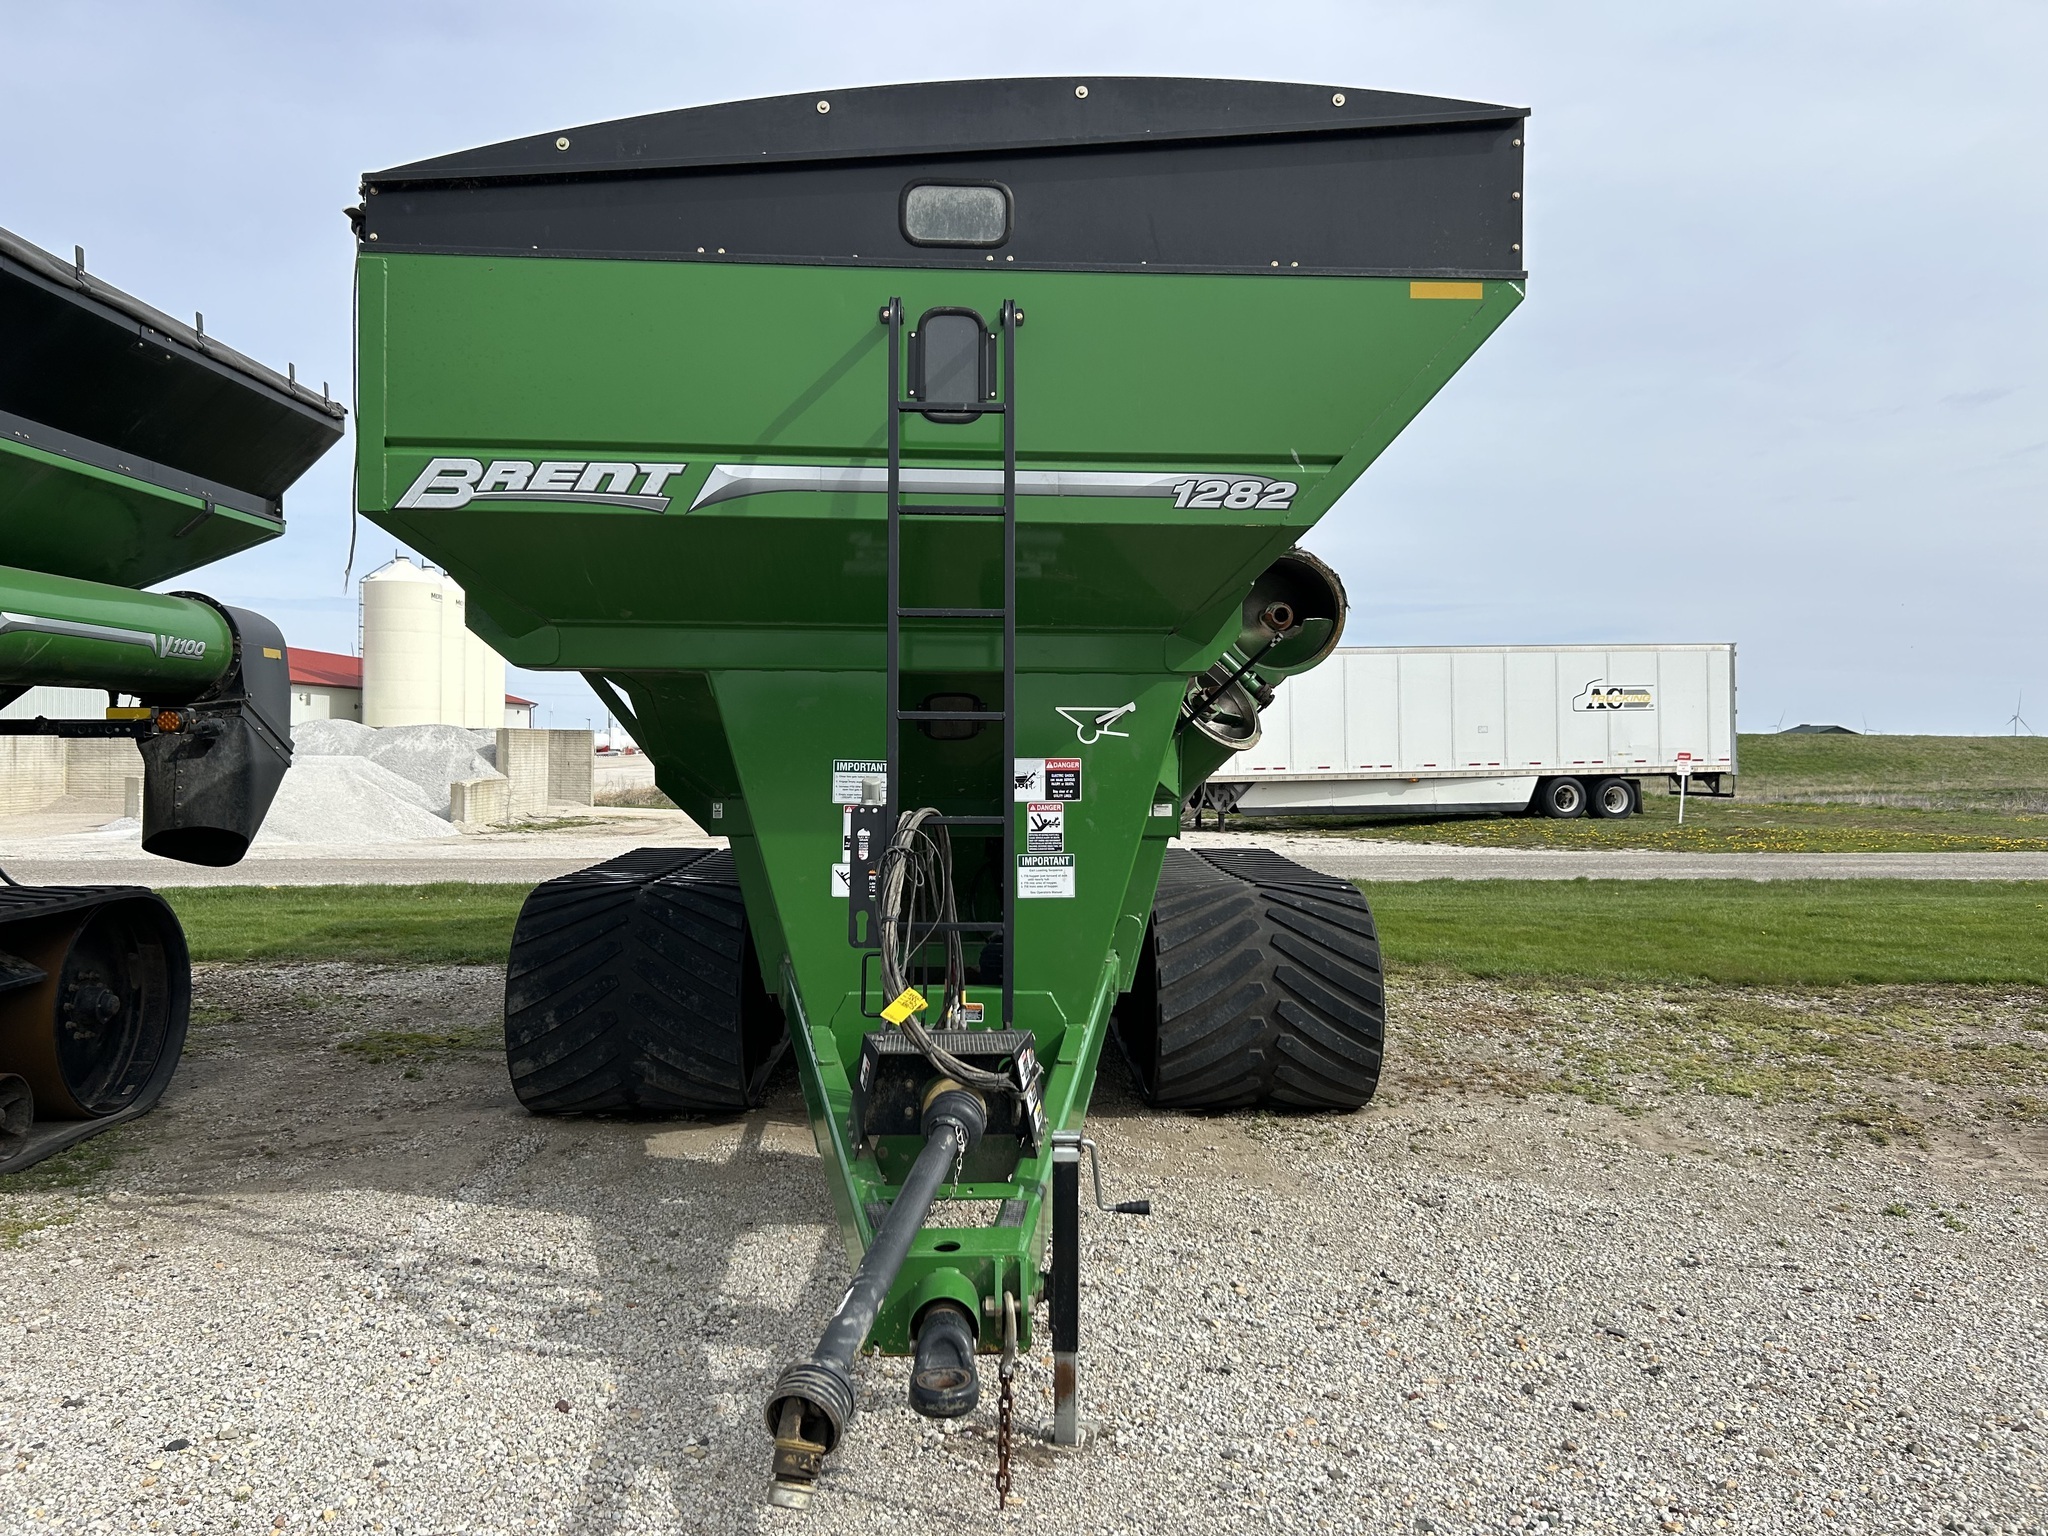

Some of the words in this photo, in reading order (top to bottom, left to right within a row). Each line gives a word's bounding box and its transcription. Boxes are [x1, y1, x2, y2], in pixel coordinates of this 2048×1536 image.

[394, 457, 687, 509] BRENT
[1172, 479, 1299, 510] 1282
[160, 634, 206, 658] V1100
[1586, 688, 1623, 709] AC
[1591, 694, 1651, 703] TRUCKING
[836, 762, 887, 772] IMPORTANT
[1022, 856, 1070, 866] IMPORTANT
